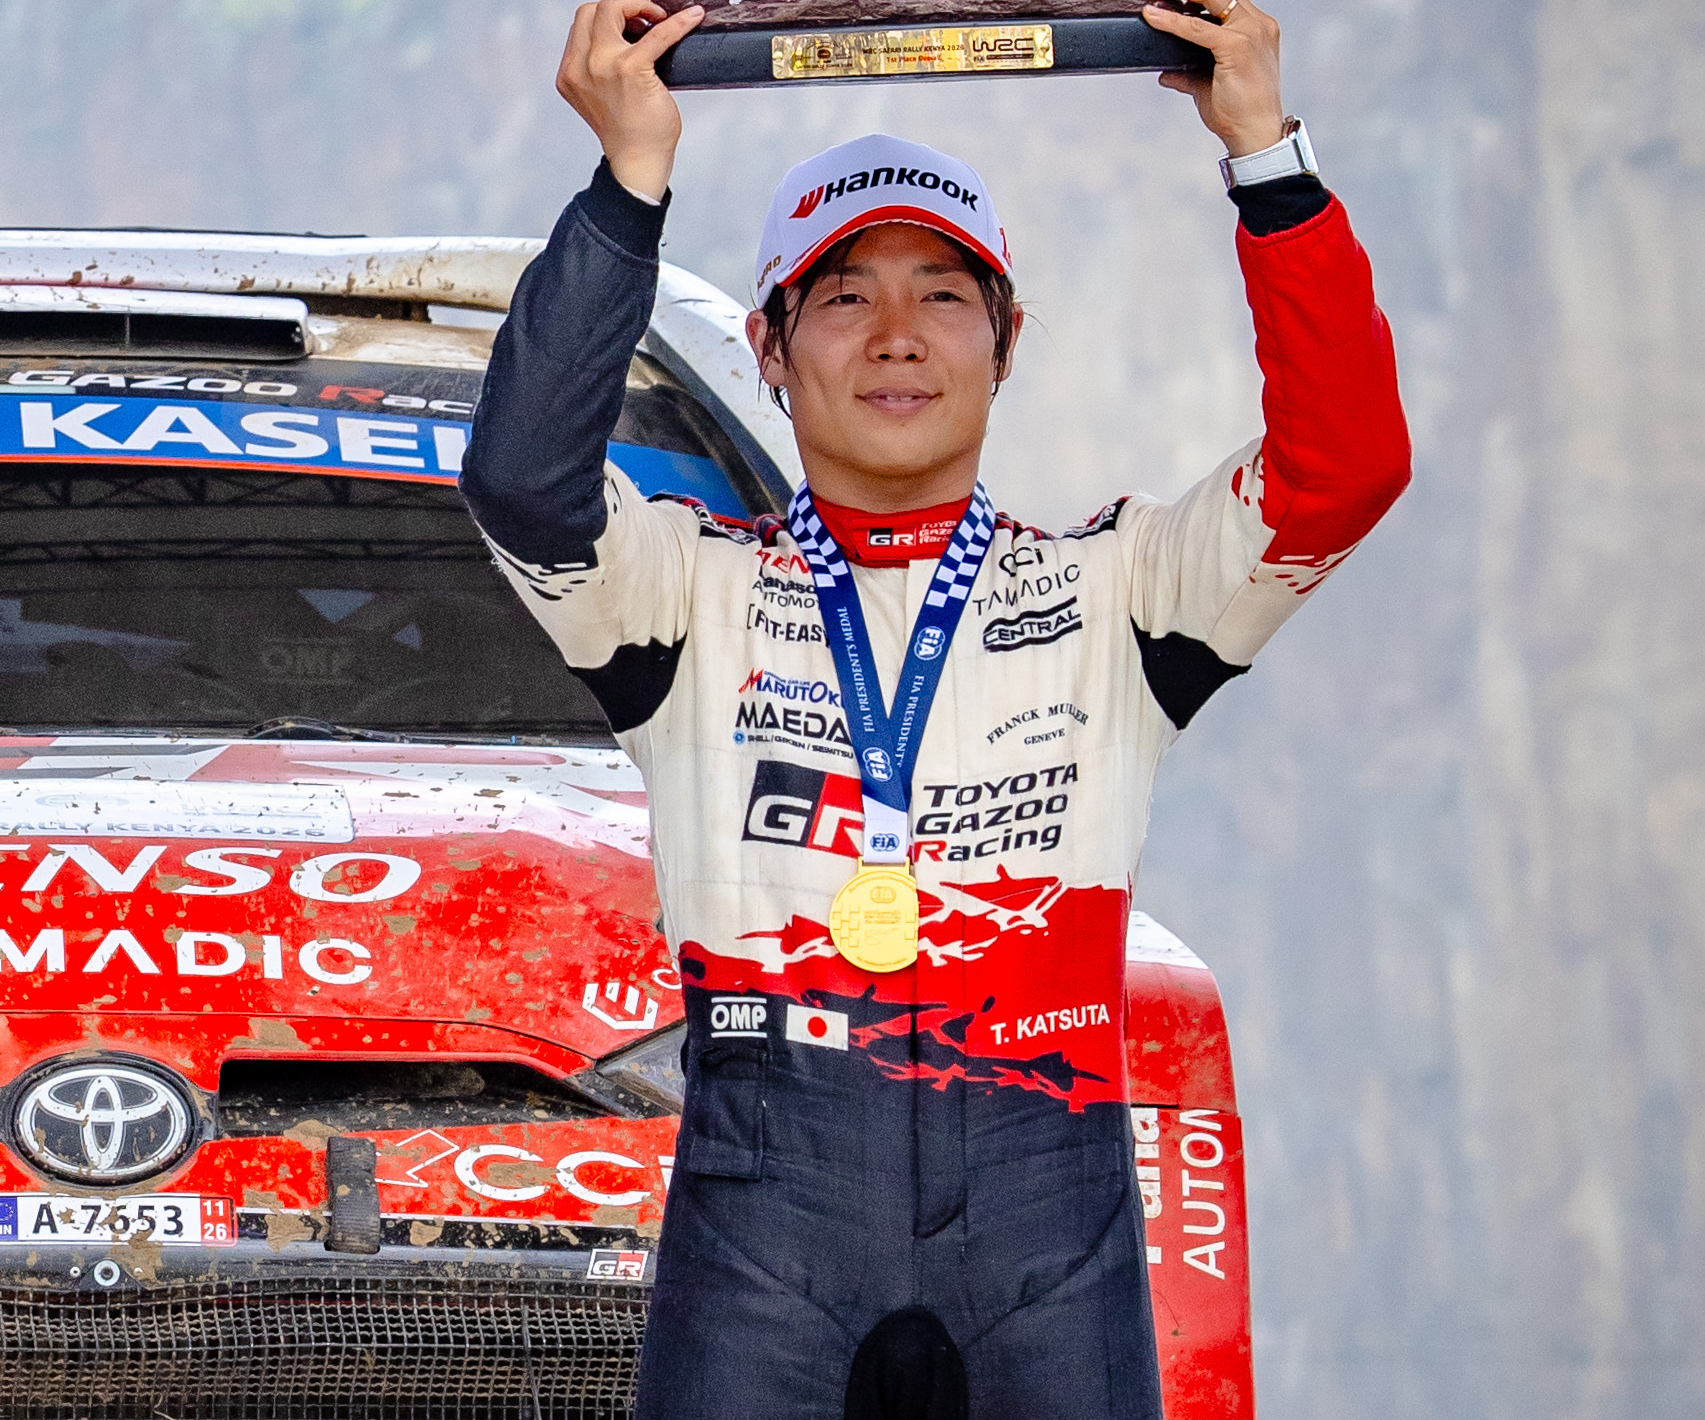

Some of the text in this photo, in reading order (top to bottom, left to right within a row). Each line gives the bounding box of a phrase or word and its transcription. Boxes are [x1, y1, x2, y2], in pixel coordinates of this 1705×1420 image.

[903, 45, 923, 53] RALLY
[973, 38, 1034, 52] WRC
[9, 368, 299, 397] GAZOO
[869, 533, 914, 546] GR
[972, 564, 1081, 616] TAMADIC
[983, 609, 1081, 645] CENTRAL
[735, 701, 853, 747] MAEDA
[986, 708, 1040, 745] FRANCK
[1023, 728, 1066, 746] GENEVE
[923, 762, 1079, 808] TOYOTA
[748, 794, 865, 848] GR
[915, 794, 1069, 836] GAZOO
[106, 823, 223, 835] KENYA
[231, 825, 327, 837] 2026
[913, 824, 1063, 862] Racing
[711, 1004, 767, 1031] OMP
[990, 1003, 1111, 1045] T. KATSUTA
[202, 1200, 224, 1217] 11
[203, 1223, 227, 1241] 26
[592, 1260, 643, 1277] GR
